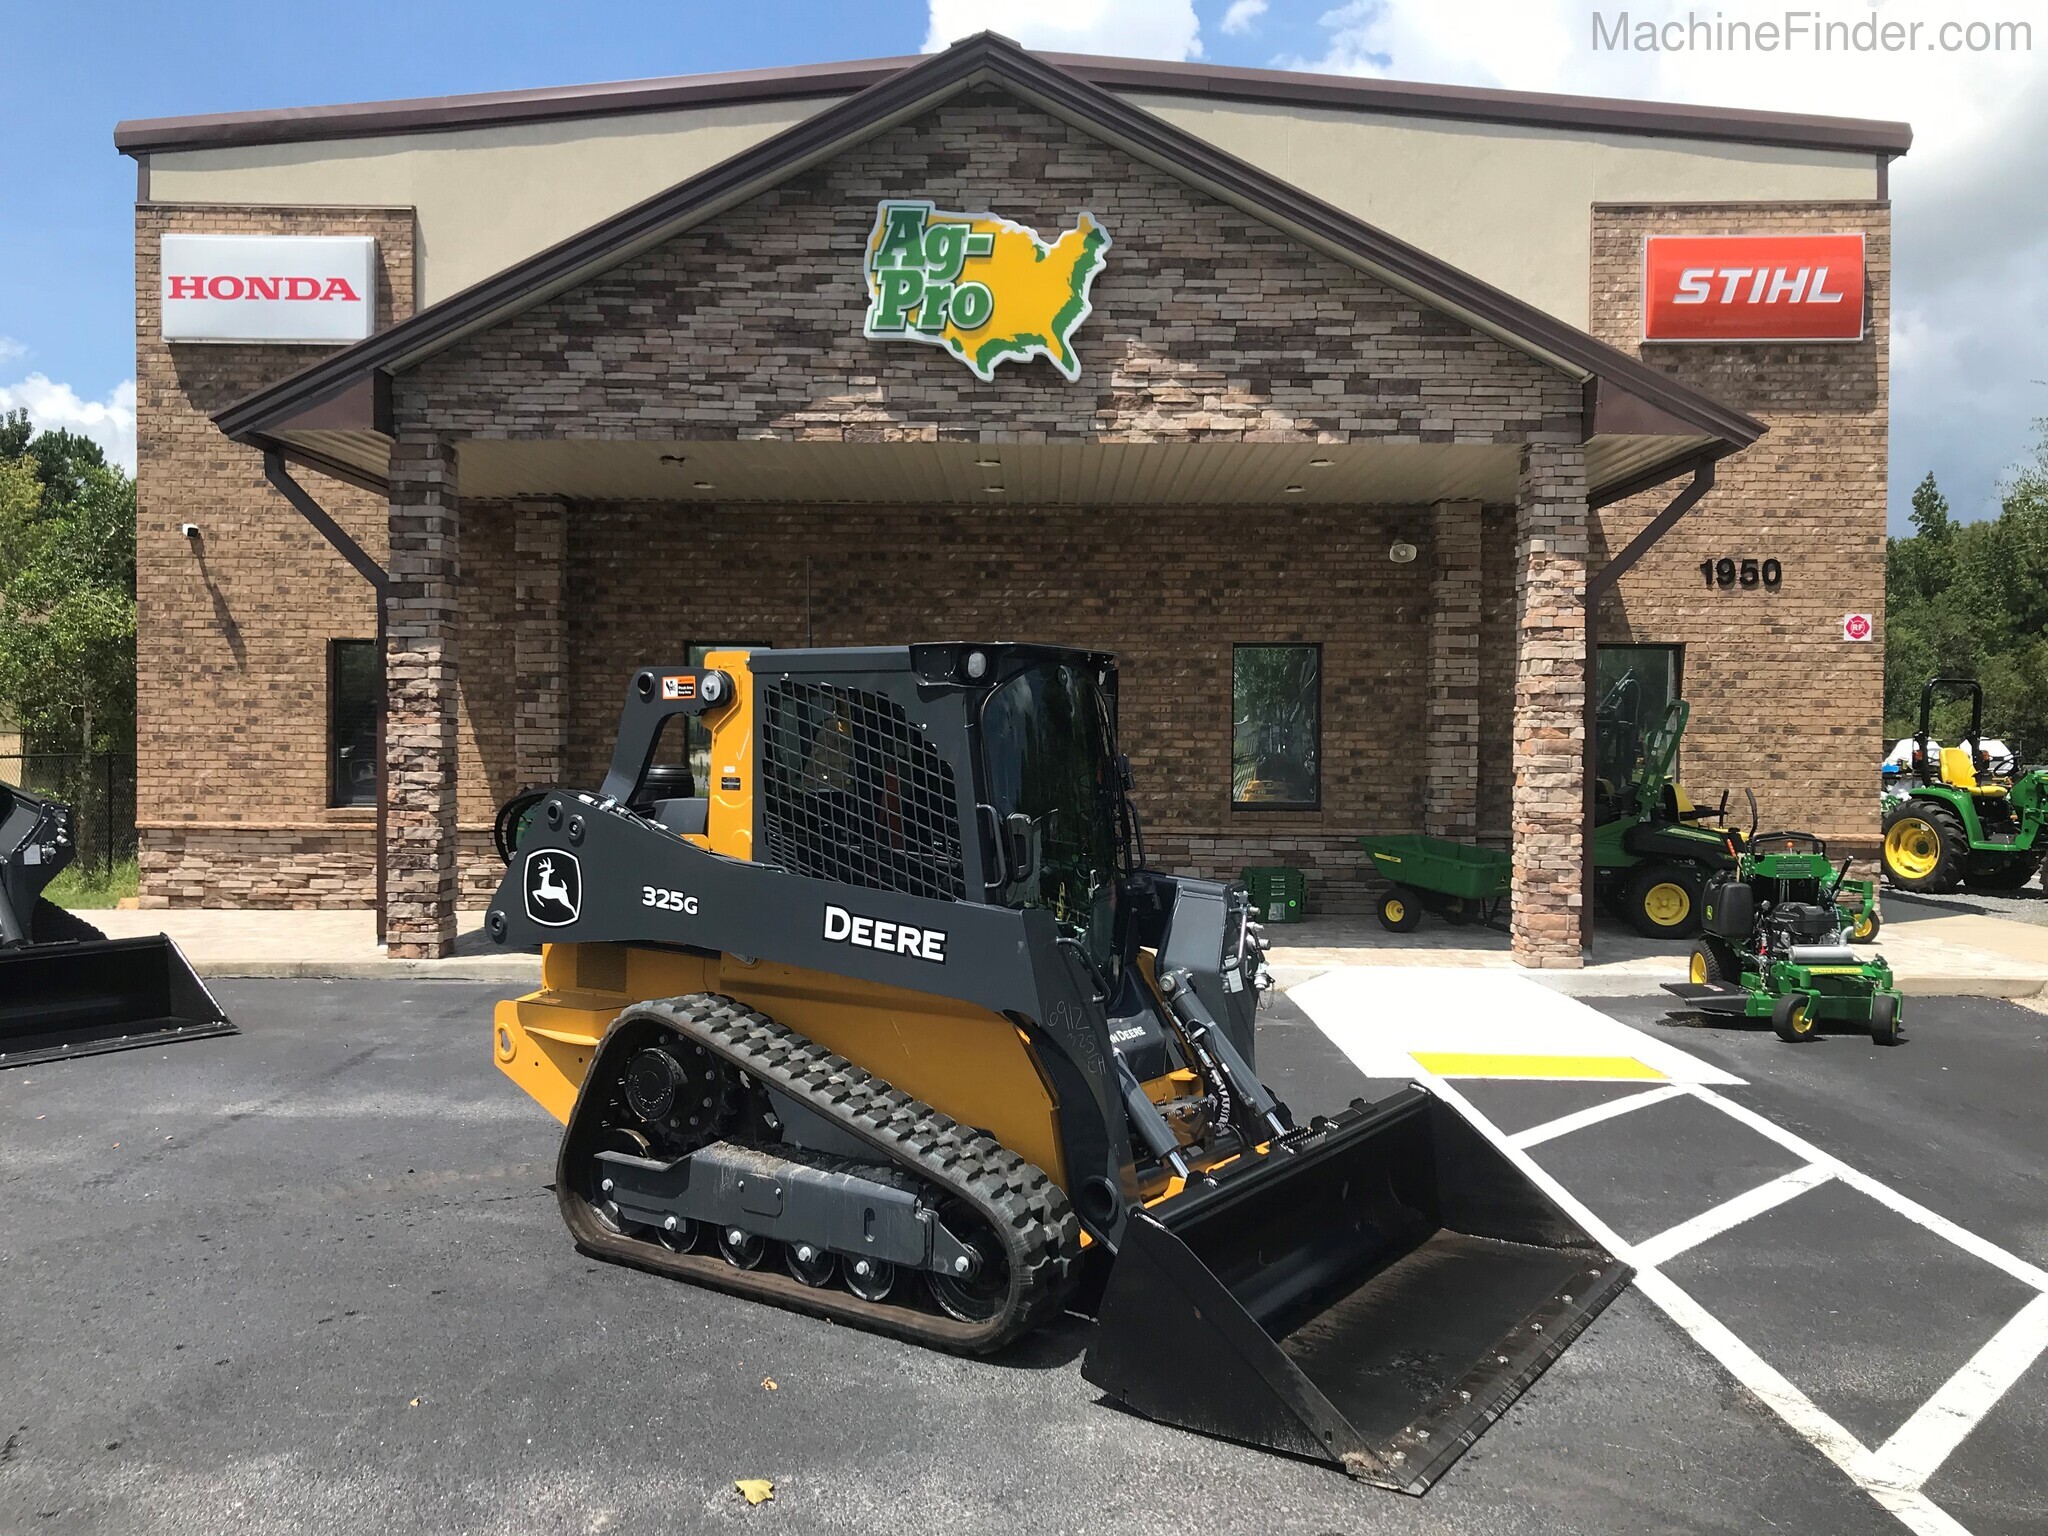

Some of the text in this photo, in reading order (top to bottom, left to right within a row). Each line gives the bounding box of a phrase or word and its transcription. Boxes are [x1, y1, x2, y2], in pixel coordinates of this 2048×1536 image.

[871, 206, 995, 283] Ag-
[168, 275, 361, 302] HONDA
[870, 269, 995, 332] Pro
[1672, 266, 1844, 304] STIHL
[1700, 558, 1782, 588] 1950
[642, 886, 698, 915] 325G
[824, 905, 946, 962] DEERE
[1115, 1026, 1146, 1041] DEERE
